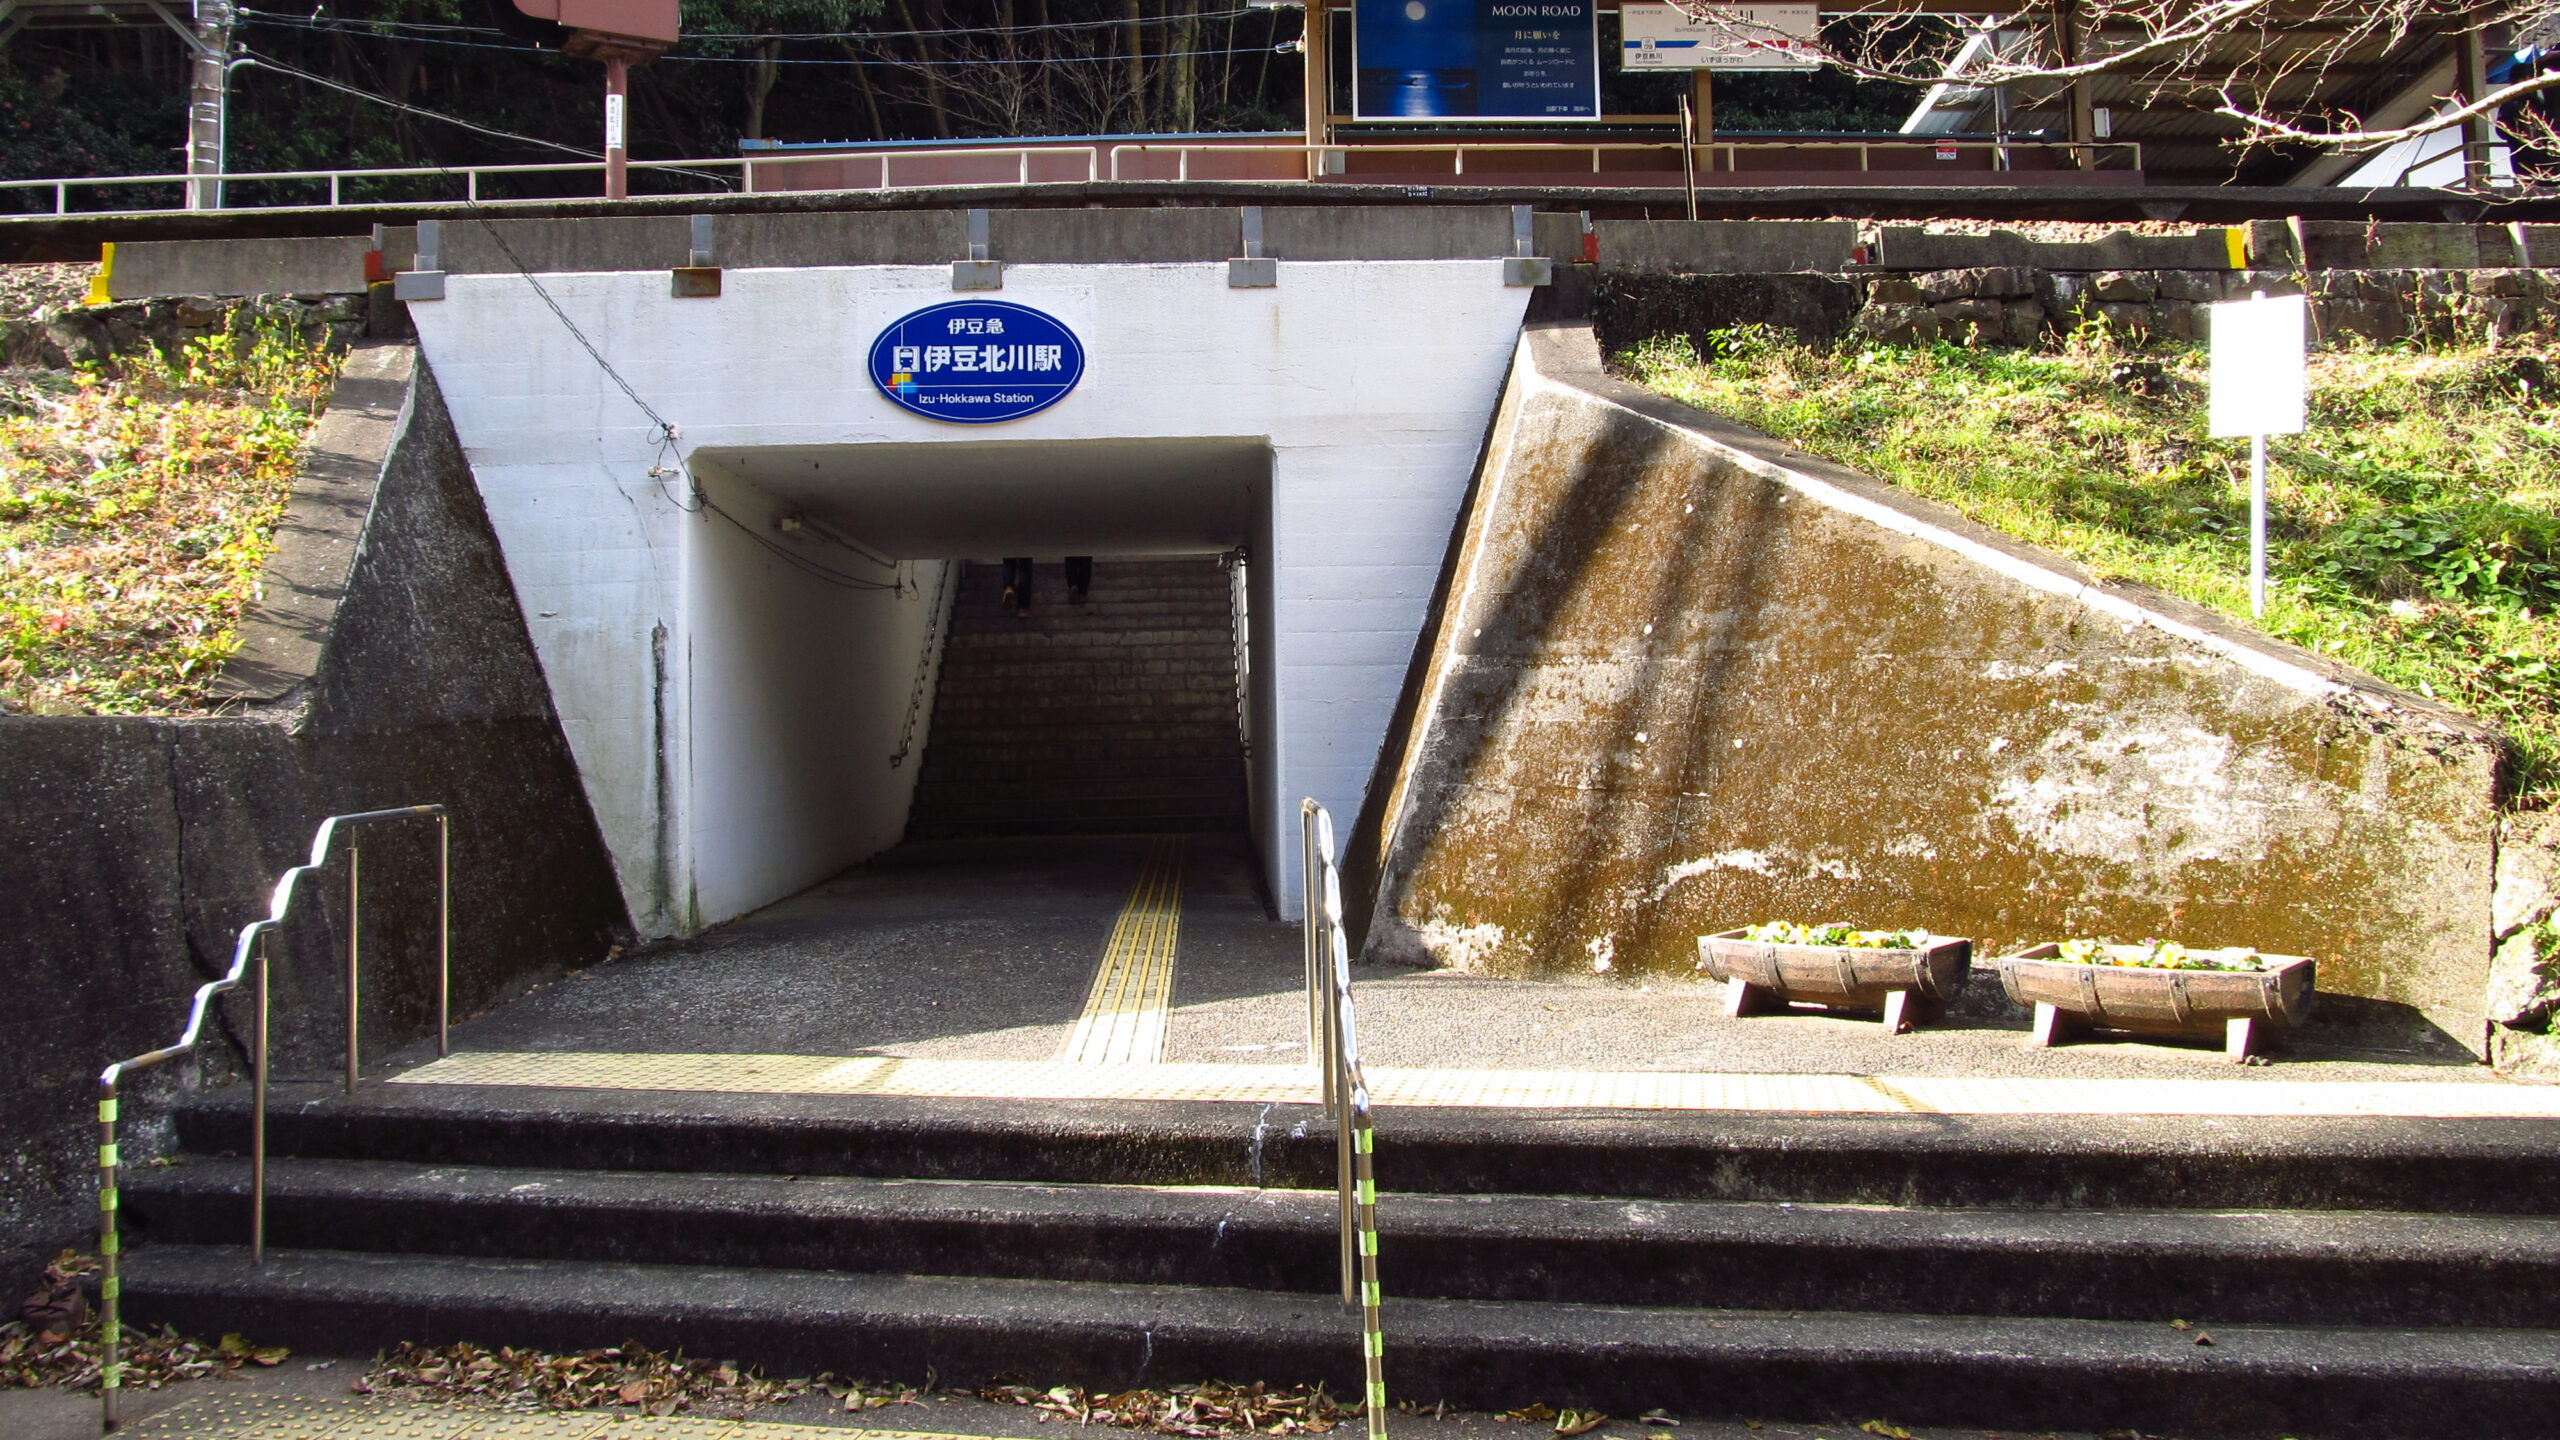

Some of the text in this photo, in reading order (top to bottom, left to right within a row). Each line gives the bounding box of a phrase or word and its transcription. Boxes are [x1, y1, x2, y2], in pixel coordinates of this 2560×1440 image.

[1492, 5, 1581, 17] MOON ROAD
[1514, 30, 1560, 40] 月に願いを
[1701, 56, 1743, 64] いずほっかわ
[947, 318, 1005, 335] 伊豆急
[924, 344, 1062, 373] 伊豆北川駅
[918, 392, 1034, 404] Izu-Hokkawa Station
